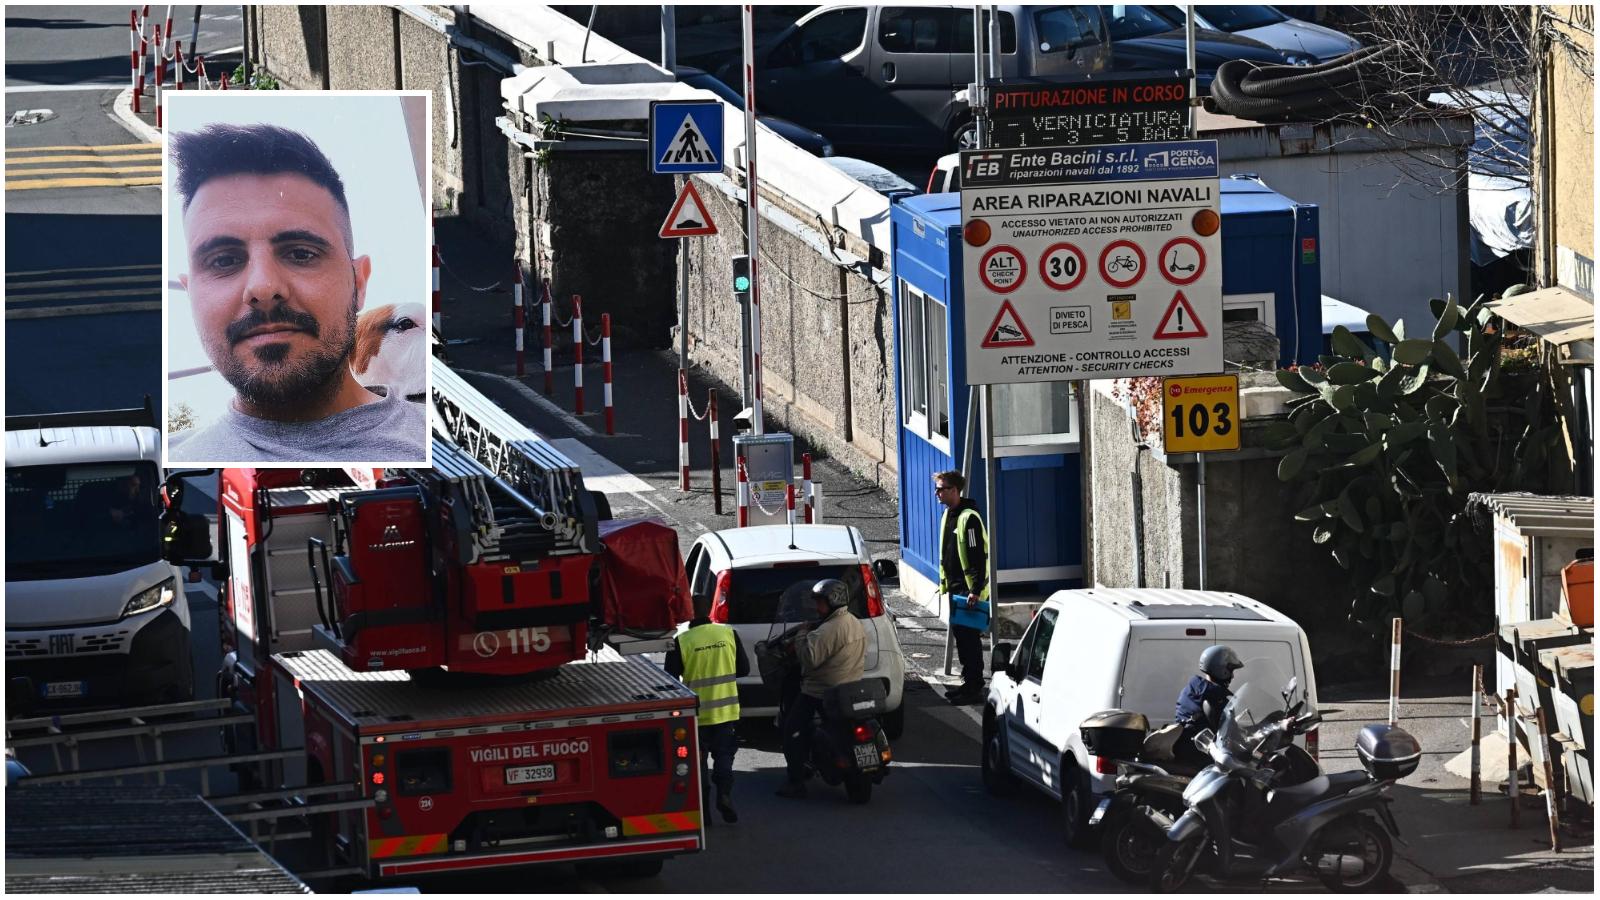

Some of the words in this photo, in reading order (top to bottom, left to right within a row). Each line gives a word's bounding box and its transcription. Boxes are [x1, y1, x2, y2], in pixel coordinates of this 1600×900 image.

[995, 88, 1107, 109] PITTURAZIONE
[1112, 87, 1128, 103] IN
[1133, 84, 1185, 102] CORSO
[1032, 110, 1181, 131] VERNICIATURA
[1019, 132, 1027, 147] 1
[1067, 130, 1079, 144] 3
[1117, 127, 1129, 142] 5
[1142, 124, 1190, 141] BACI
[1009, 153, 1047, 168] Ente
[1050, 149, 1102, 166] Bacini
[1105, 148, 1139, 164] s.r.l.
[1170, 149, 1199, 157] PORTS
[1170, 156, 1215, 167] GENOA
[1009, 166, 1063, 180] riparazioni
[1065, 165, 1095, 177] navali
[1097, 164, 1114, 175] dal
[1116, 164, 1140, 174] 1892
[972, 195, 1023, 211] AREA
[1027, 190, 1142, 209] RIPARAZIONI
[1147, 186, 1211, 204] NAVALI
[1001, 219, 1046, 229] ACCESSO
[1048, 217, 1087, 227] VIETATO
[1088, 216, 1099, 225] AI
[1100, 215, 1120, 224] NON
[1122, 213, 1183, 223] AUTORIZZATI
[1012, 227, 1080, 238] UNAUTHORIZED
[1082, 225, 1118, 235] ACCESS
[1119, 223, 1173, 233] PROHIBITED
[989, 257, 1015, 269] ALT
[1050, 256, 1077, 278] 30
[1055, 310, 1086, 320] DIVIETO
[1052, 321, 1061, 330] DI
[1062, 320, 1089, 329] PESCA
[1001, 353, 1067, 365] ATTENZIONE
[1075, 350, 1141, 362] CONTROLLO
[1143, 347, 1190, 358] ACCESSI
[1017, 364, 1074, 375] ATTENTION
[1081, 361, 1131, 373] SECURITY
[1132, 359, 1174, 370] CHECKS
[1183, 386, 1233, 395] Emergenza
[1171, 402, 1232, 438] 103
[49, 633, 75, 655] FIAT
[507, 627, 551, 655] 115
[470, 747, 509, 763] VIGILI
[513, 745, 539, 759] DEL
[543, 741, 589, 756] FUOCO
[508, 769, 520, 782] VF
[525, 766, 553, 781] 32938
